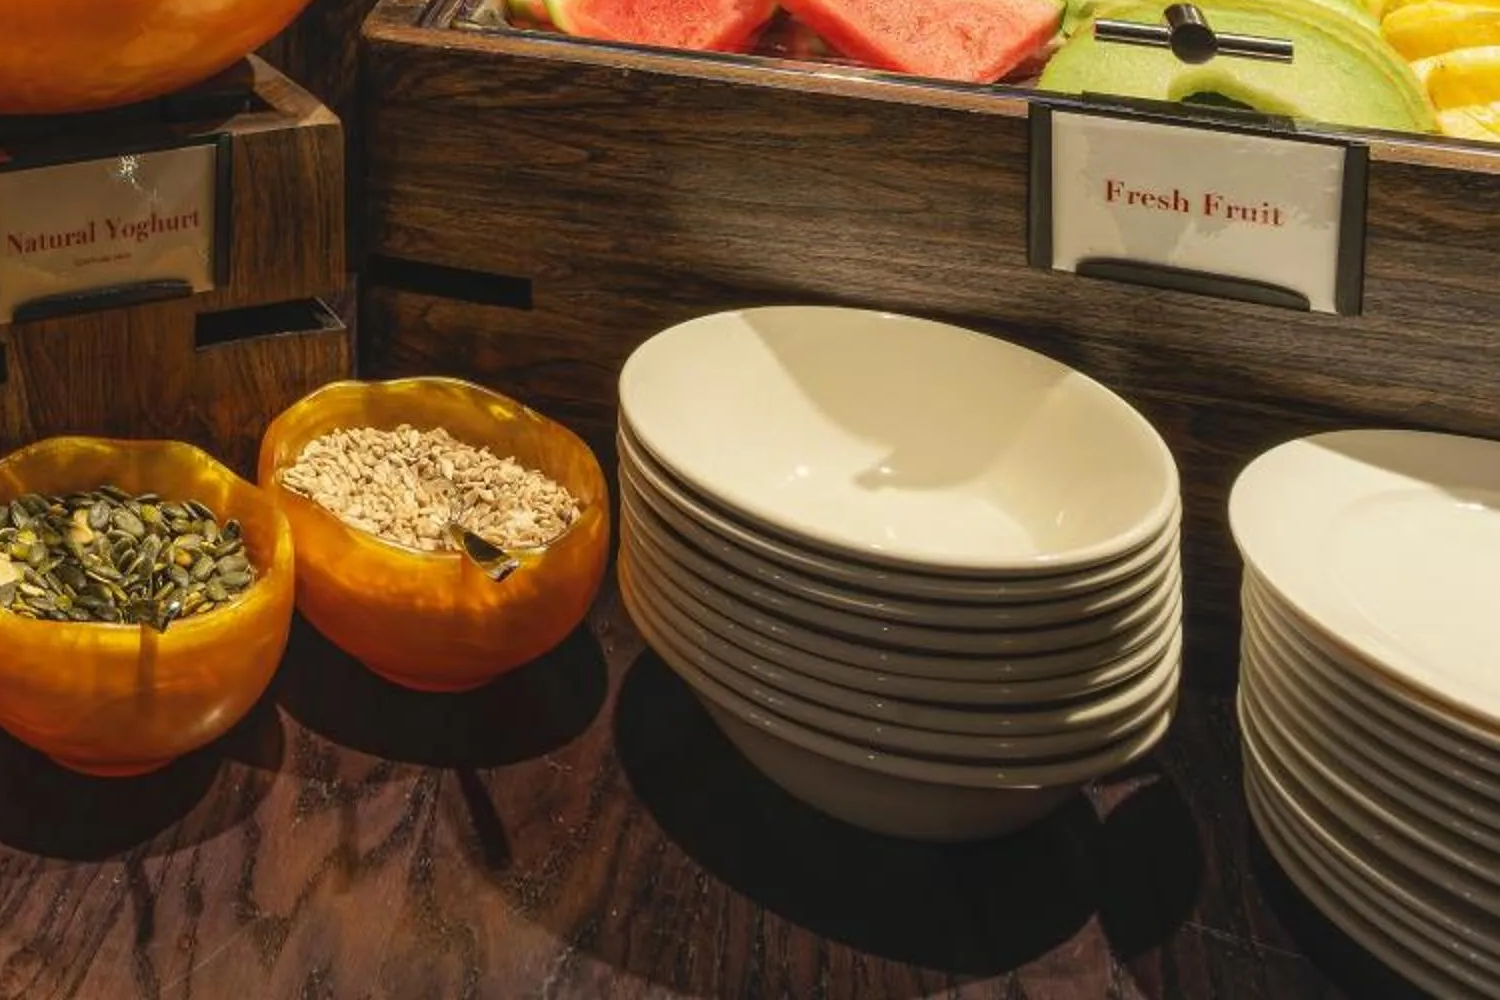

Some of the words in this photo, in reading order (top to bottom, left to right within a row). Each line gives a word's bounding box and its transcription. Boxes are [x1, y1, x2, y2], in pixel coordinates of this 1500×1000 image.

[1103, 179, 1190, 214] Fresh
[1202, 192, 1284, 227] Fruit
[6, 222, 96, 254] Natural
[105, 210, 200, 244] Yoghurt
